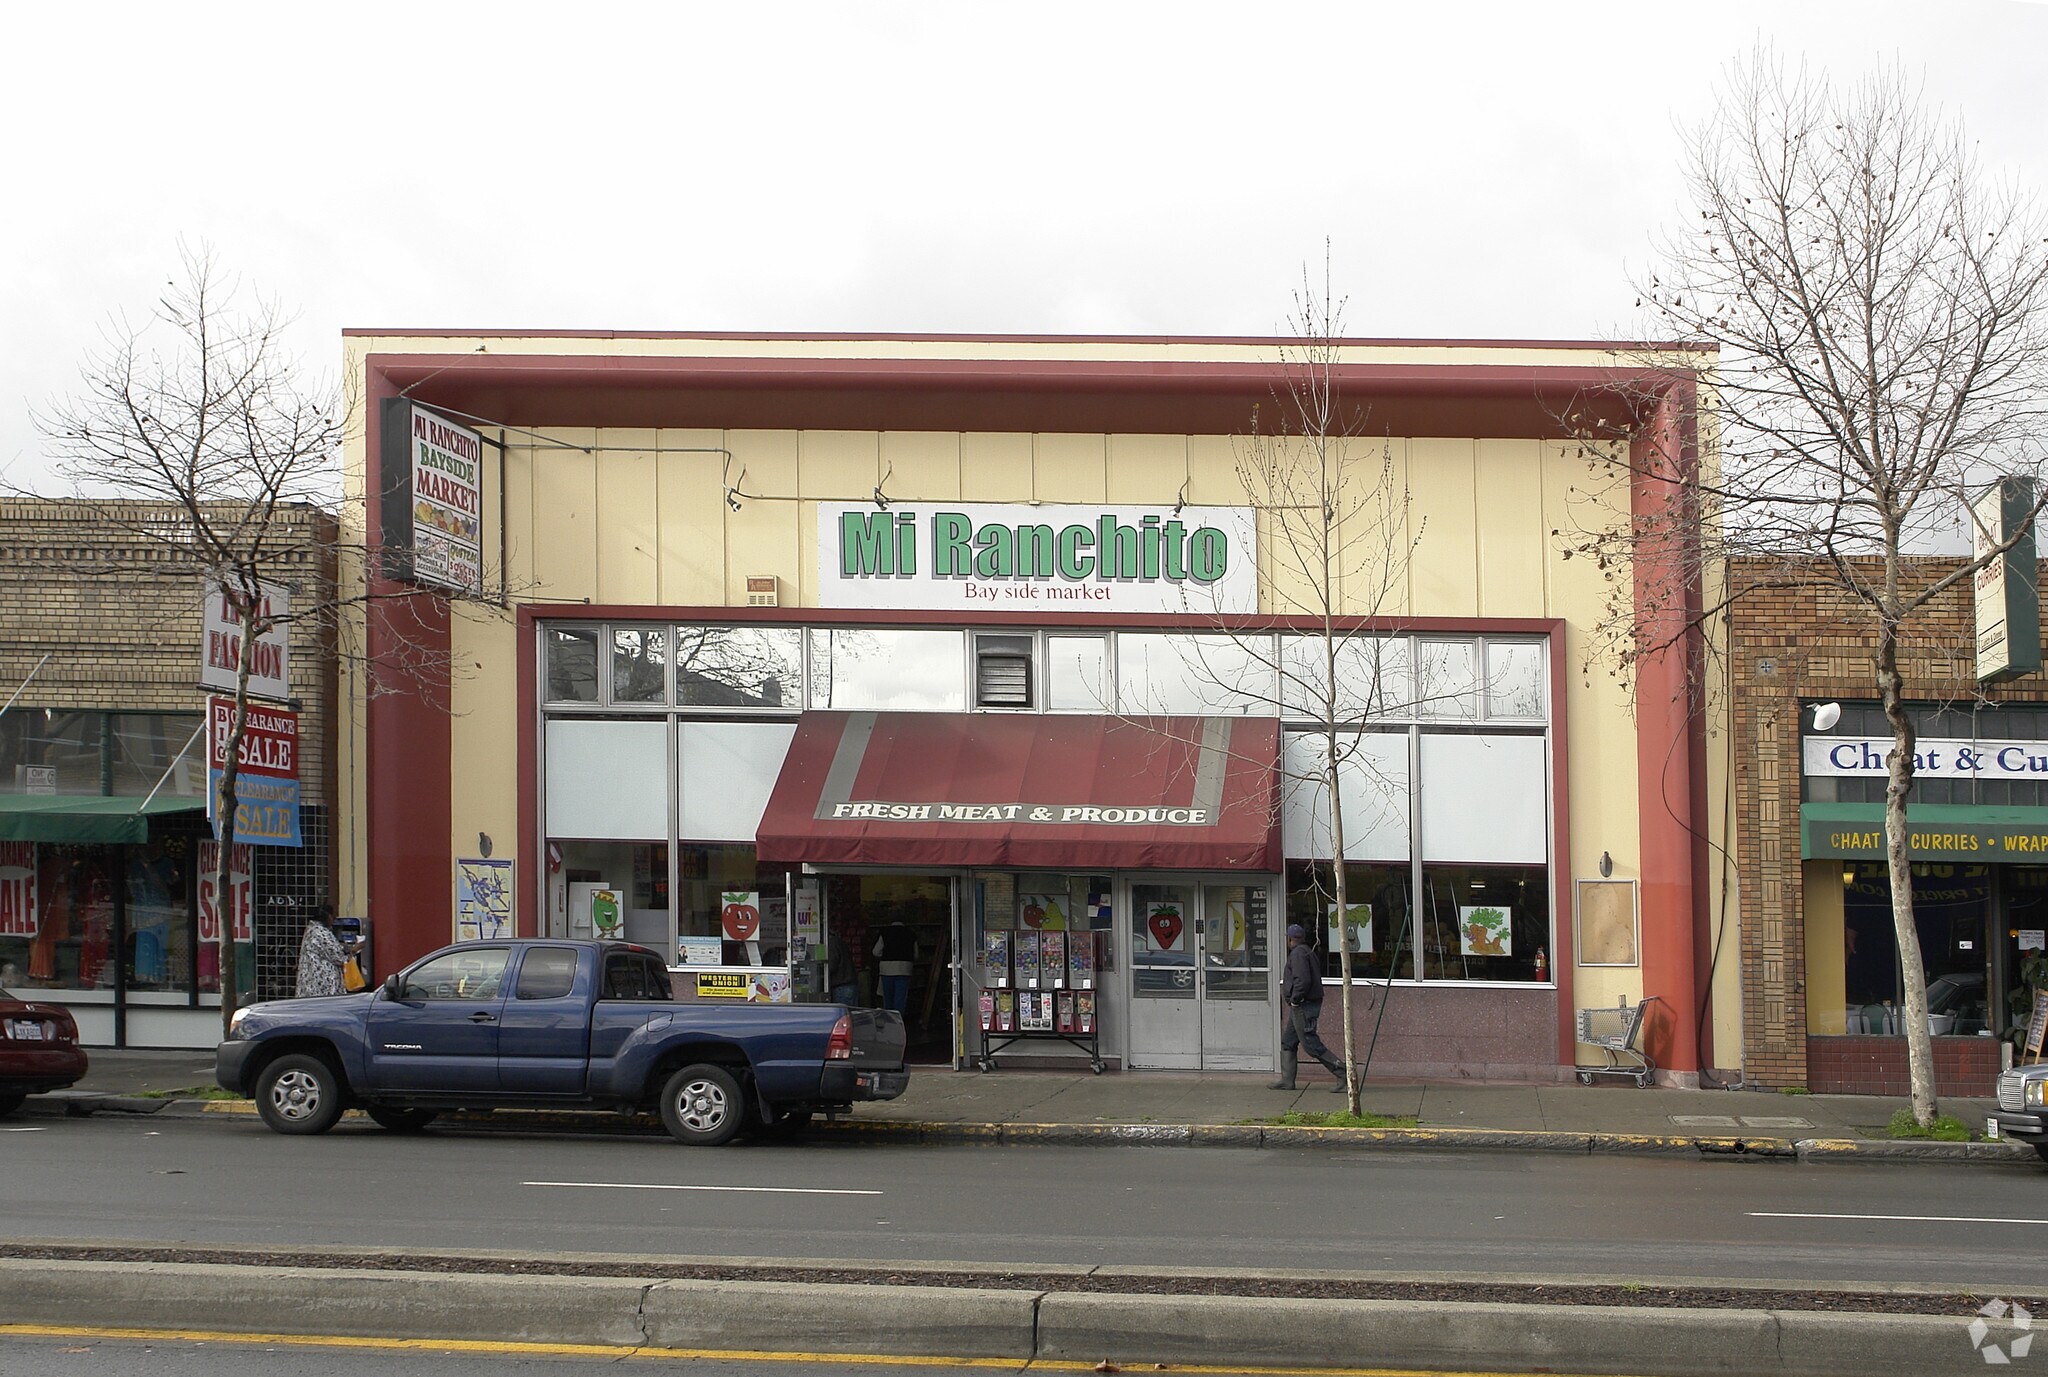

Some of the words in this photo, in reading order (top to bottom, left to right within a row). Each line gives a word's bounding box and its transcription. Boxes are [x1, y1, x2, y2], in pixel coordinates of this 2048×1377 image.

[414, 414, 427, 441] MI
[430, 420, 478, 463] RANCHITO
[419, 442, 474, 486] BAYSIDE
[416, 468, 478, 515] MARKET
[839, 511, 916, 579] Mi
[931, 512, 1227, 585] Ranchito
[965, 582, 999, 602] Bay
[1004, 583, 1040, 600] side
[1046, 583, 1111, 601] market
[1977, 560, 2002, 591] CURRIES
[208, 630, 283, 680] FASION
[230, 710, 295, 735] CEARANCE
[238, 734, 291, 771] SALE
[1829, 742, 1940, 770] Chat
[1955, 748, 1984, 771] &
[236, 804, 292, 838] SALE
[832, 803, 930, 820] FRESH
[938, 805, 1021, 822] MEAT
[1029, 806, 1052, 823] &
[1061, 806, 1207, 824] PRODUCE
[1830, 832, 1881, 850] CHAAT
[1910, 833, 1979, 851] CURRIES
[2004, 834, 2048, 852] WRAP
